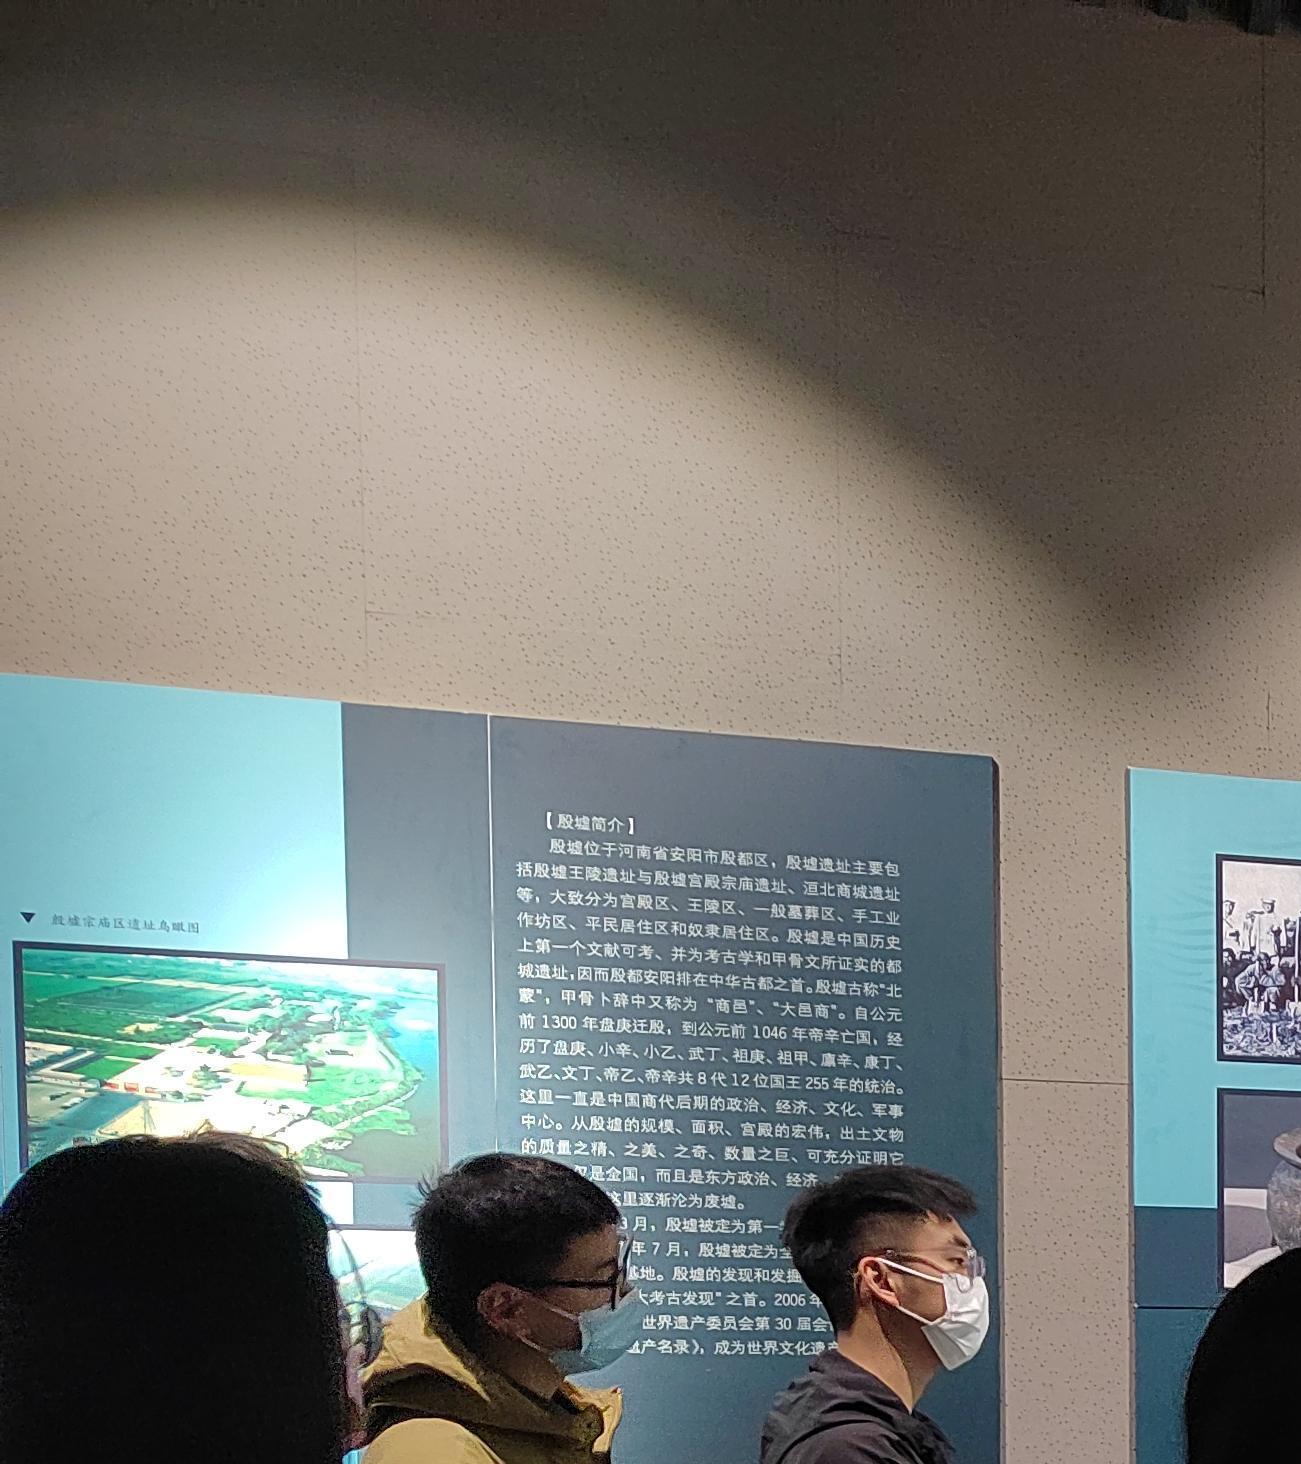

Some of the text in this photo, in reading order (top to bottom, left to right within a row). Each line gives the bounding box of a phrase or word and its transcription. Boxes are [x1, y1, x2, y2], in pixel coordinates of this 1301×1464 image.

[546, 811, 635, 835] 【殷墟简介】
[549, 838, 900, 877] 殷墟位于河南省安阳市殷都区，殷墟遗址主要包
[516, 861, 901, 902] 括殷墟王陵遗址与殷墟宫殿宗庙遗址、洹北商城遗址
[516, 886, 901, 926] 等，大致分为宫殿区、王陵区、一般墓葬区、手工业
[517, 937, 902, 974] 上第一个文献可考、并为考古学和甲骨文所证实的都
[519, 1088, 904, 1119] 这里一直是中国商代后期的政治、经济、文化、军事
